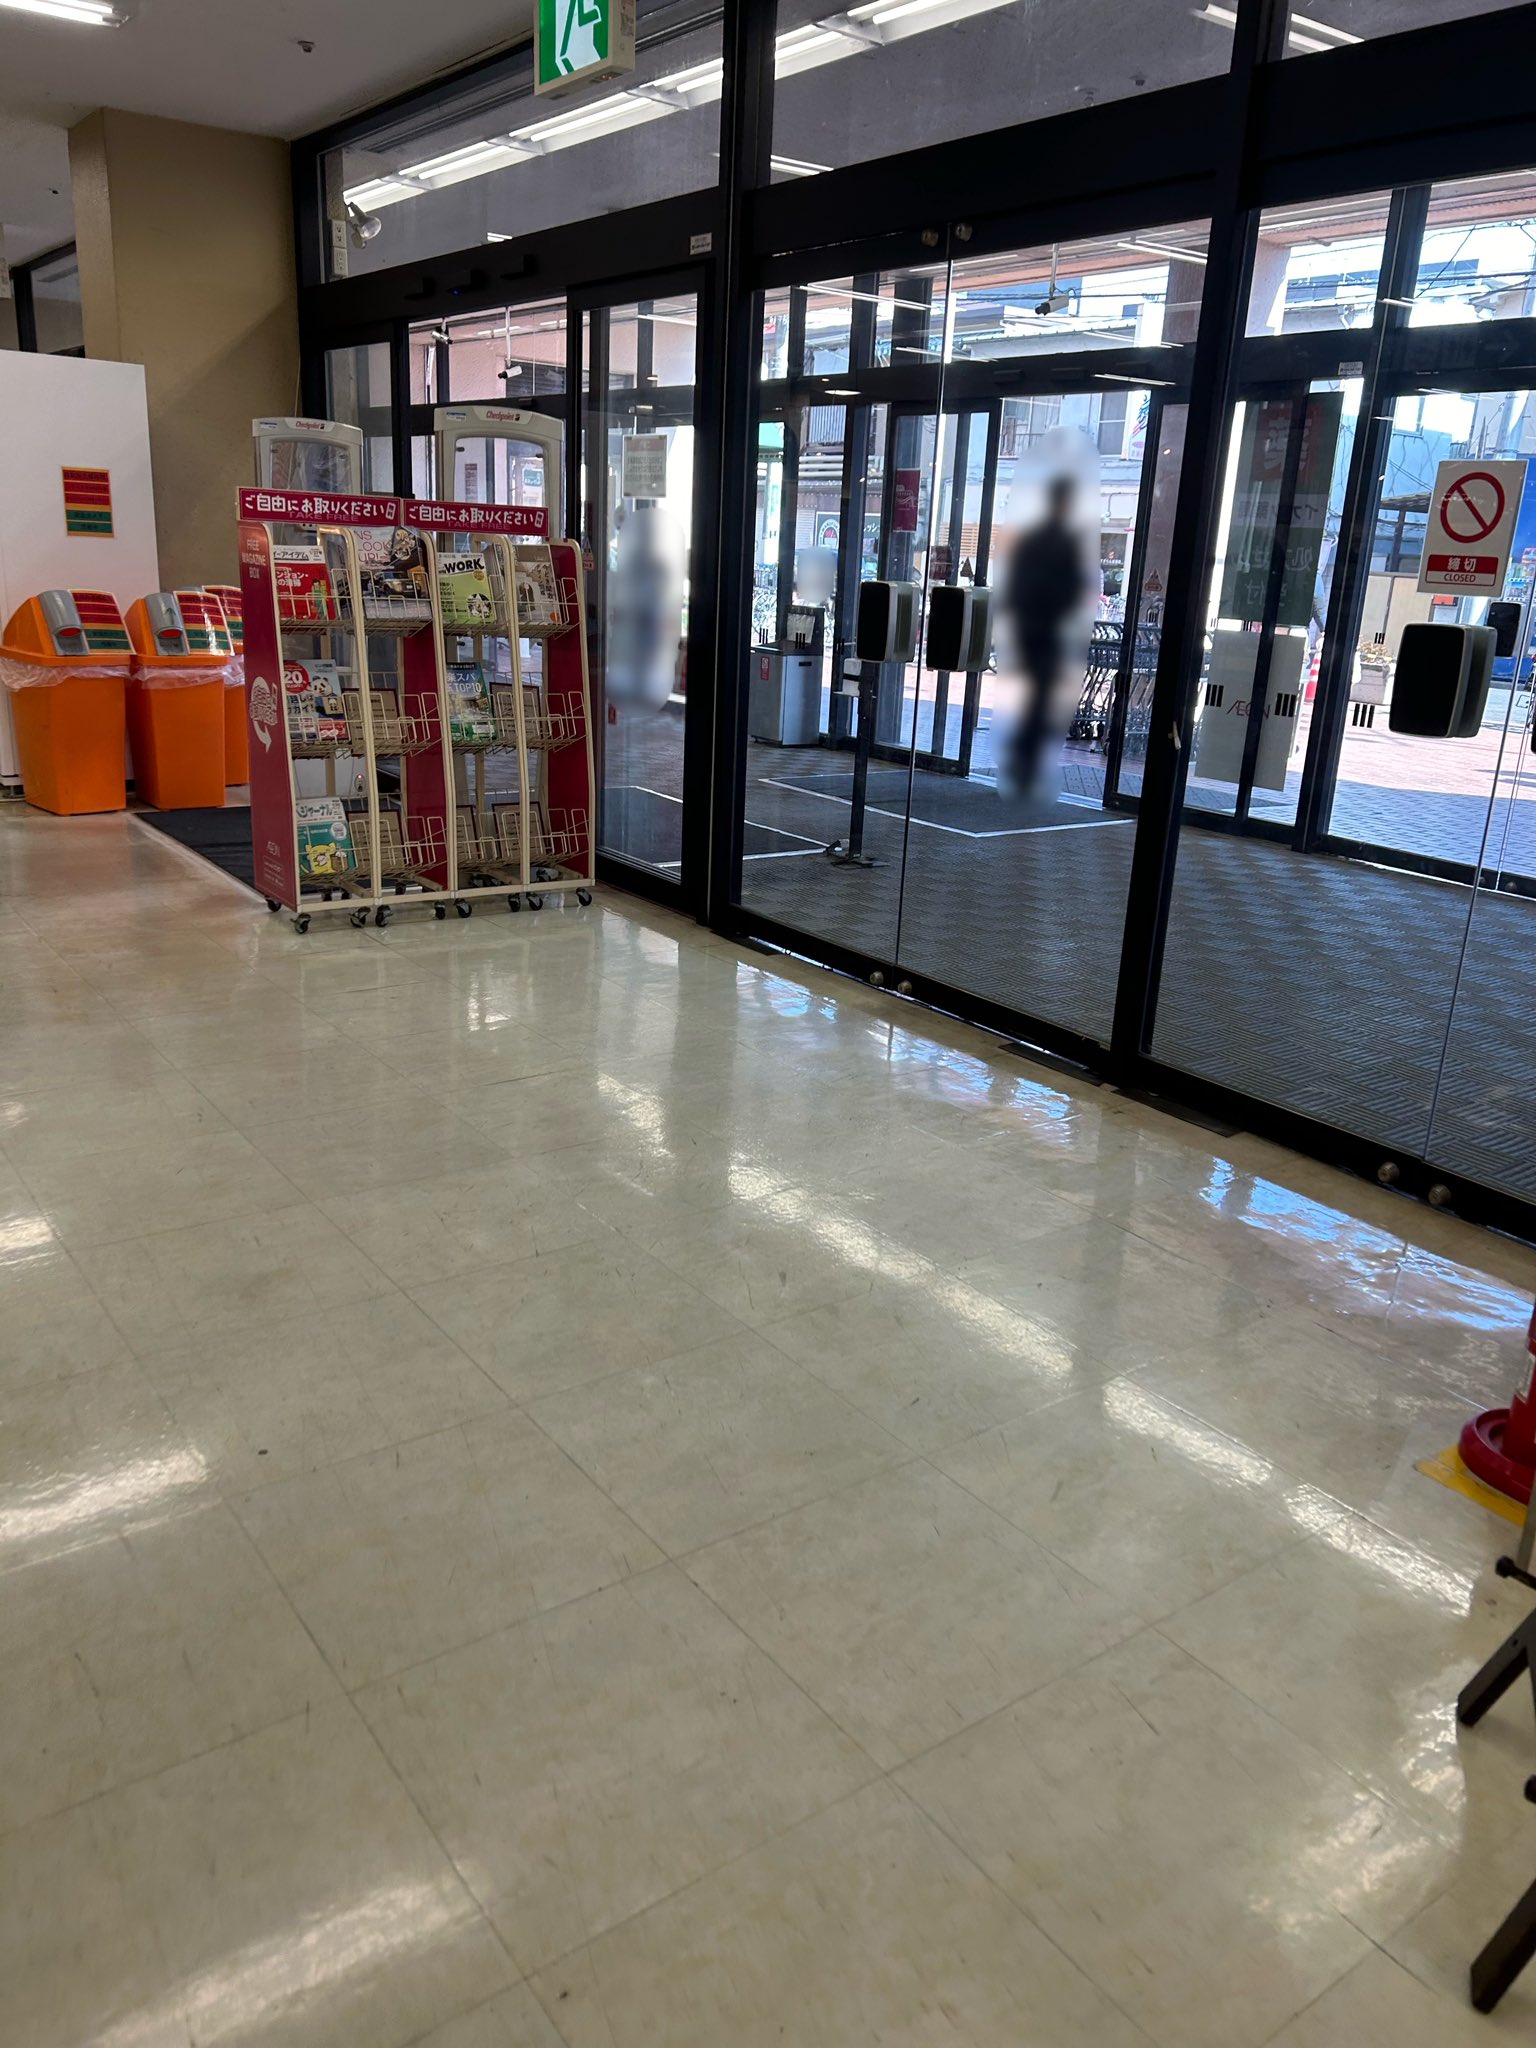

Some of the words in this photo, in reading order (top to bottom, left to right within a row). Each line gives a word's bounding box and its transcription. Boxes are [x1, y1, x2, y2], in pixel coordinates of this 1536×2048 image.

[245, 493, 385, 516] ご自由にお取りください
[288, 510, 322, 520] TAKE
[326, 513, 359, 522] FREE
[409, 504, 534, 525] ご自由にお取りください
[447, 520, 478, 529] TAKE
[481, 522, 511, 531] FREE
[247, 539, 260, 551] FREE
[242, 552, 266, 567] MAGAZINE
[1447, 556, 1477, 572] 締切
[249, 566, 260, 579] BOX
[1443, 573, 1477, 583] CLOSED
